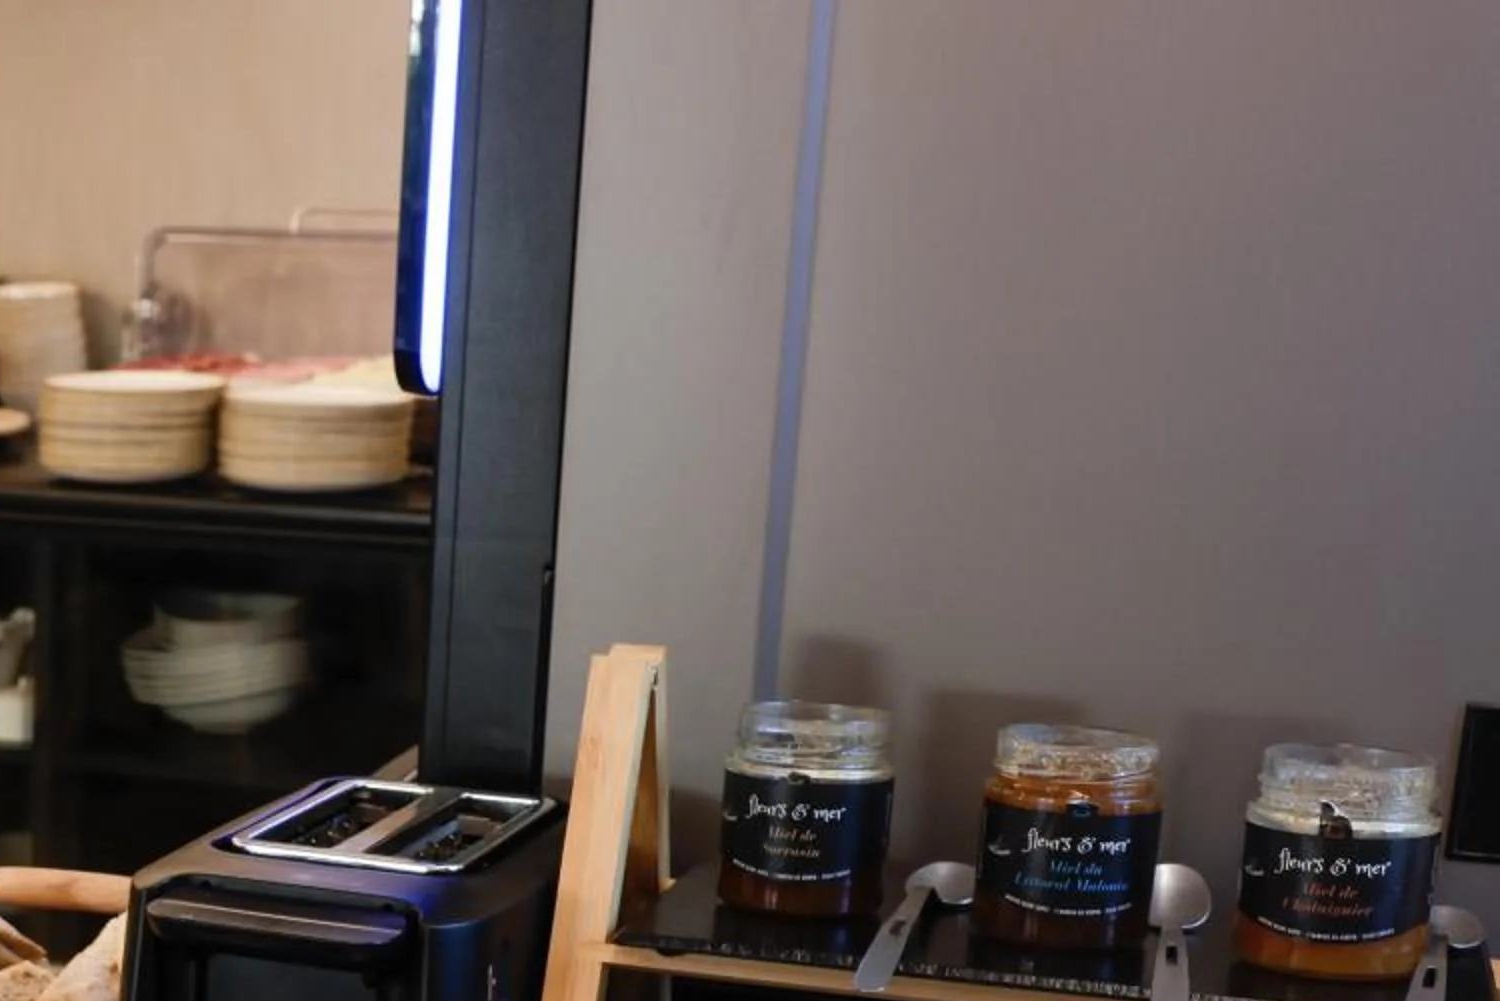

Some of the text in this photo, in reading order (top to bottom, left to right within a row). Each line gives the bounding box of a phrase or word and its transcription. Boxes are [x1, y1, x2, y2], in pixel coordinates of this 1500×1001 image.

[813, 806, 847, 823] mer
[1099, 838, 1132, 856] mer
[1355, 861, 1393, 879] mer
